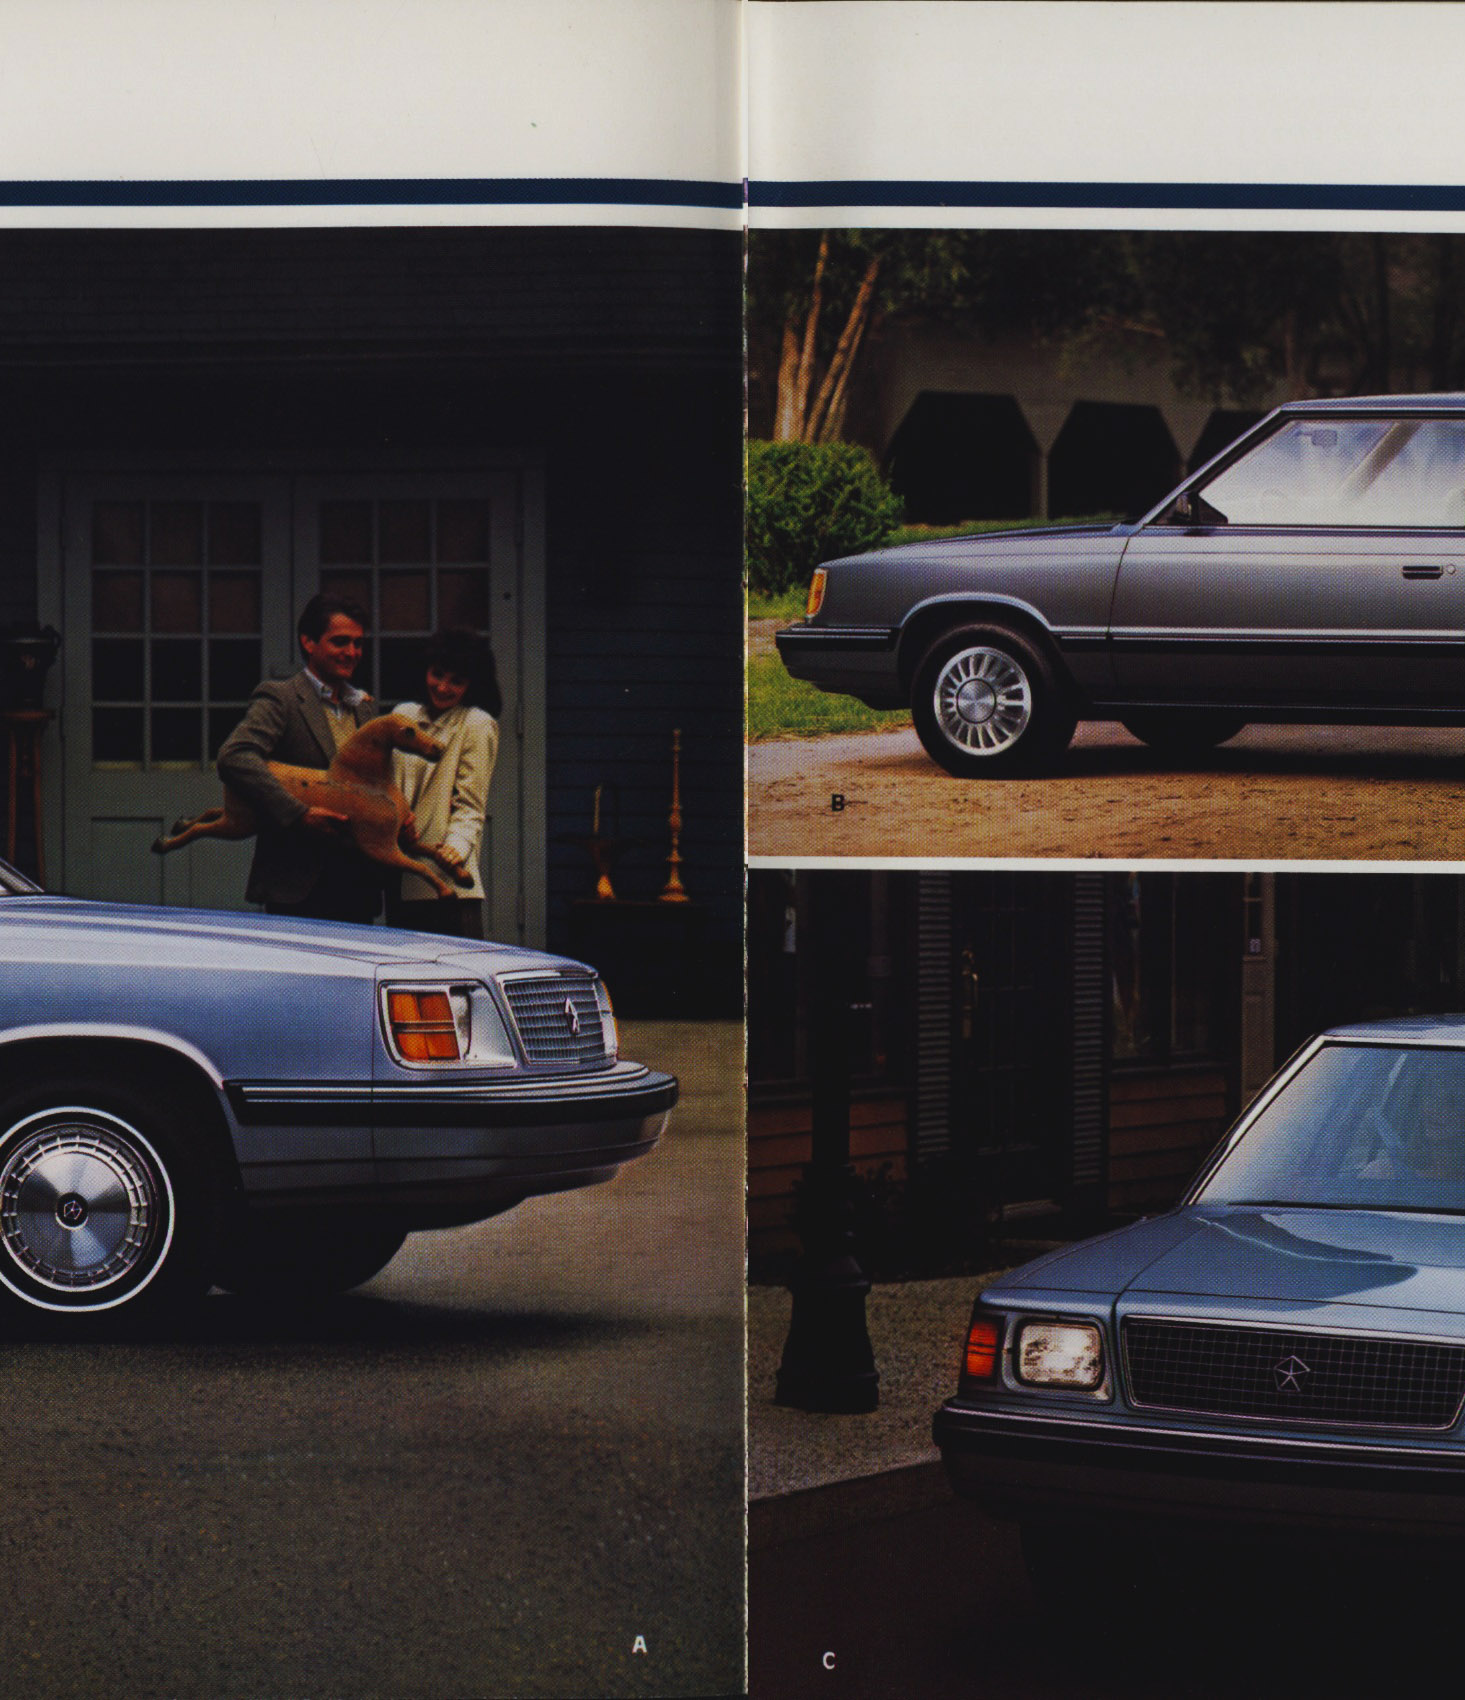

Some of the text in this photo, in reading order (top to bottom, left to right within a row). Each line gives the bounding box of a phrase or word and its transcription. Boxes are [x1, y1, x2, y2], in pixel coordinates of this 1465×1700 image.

[831, 793, 846, 812] B
[632, 1635, 648, 1653] A
[822, 1651, 835, 1670] C
